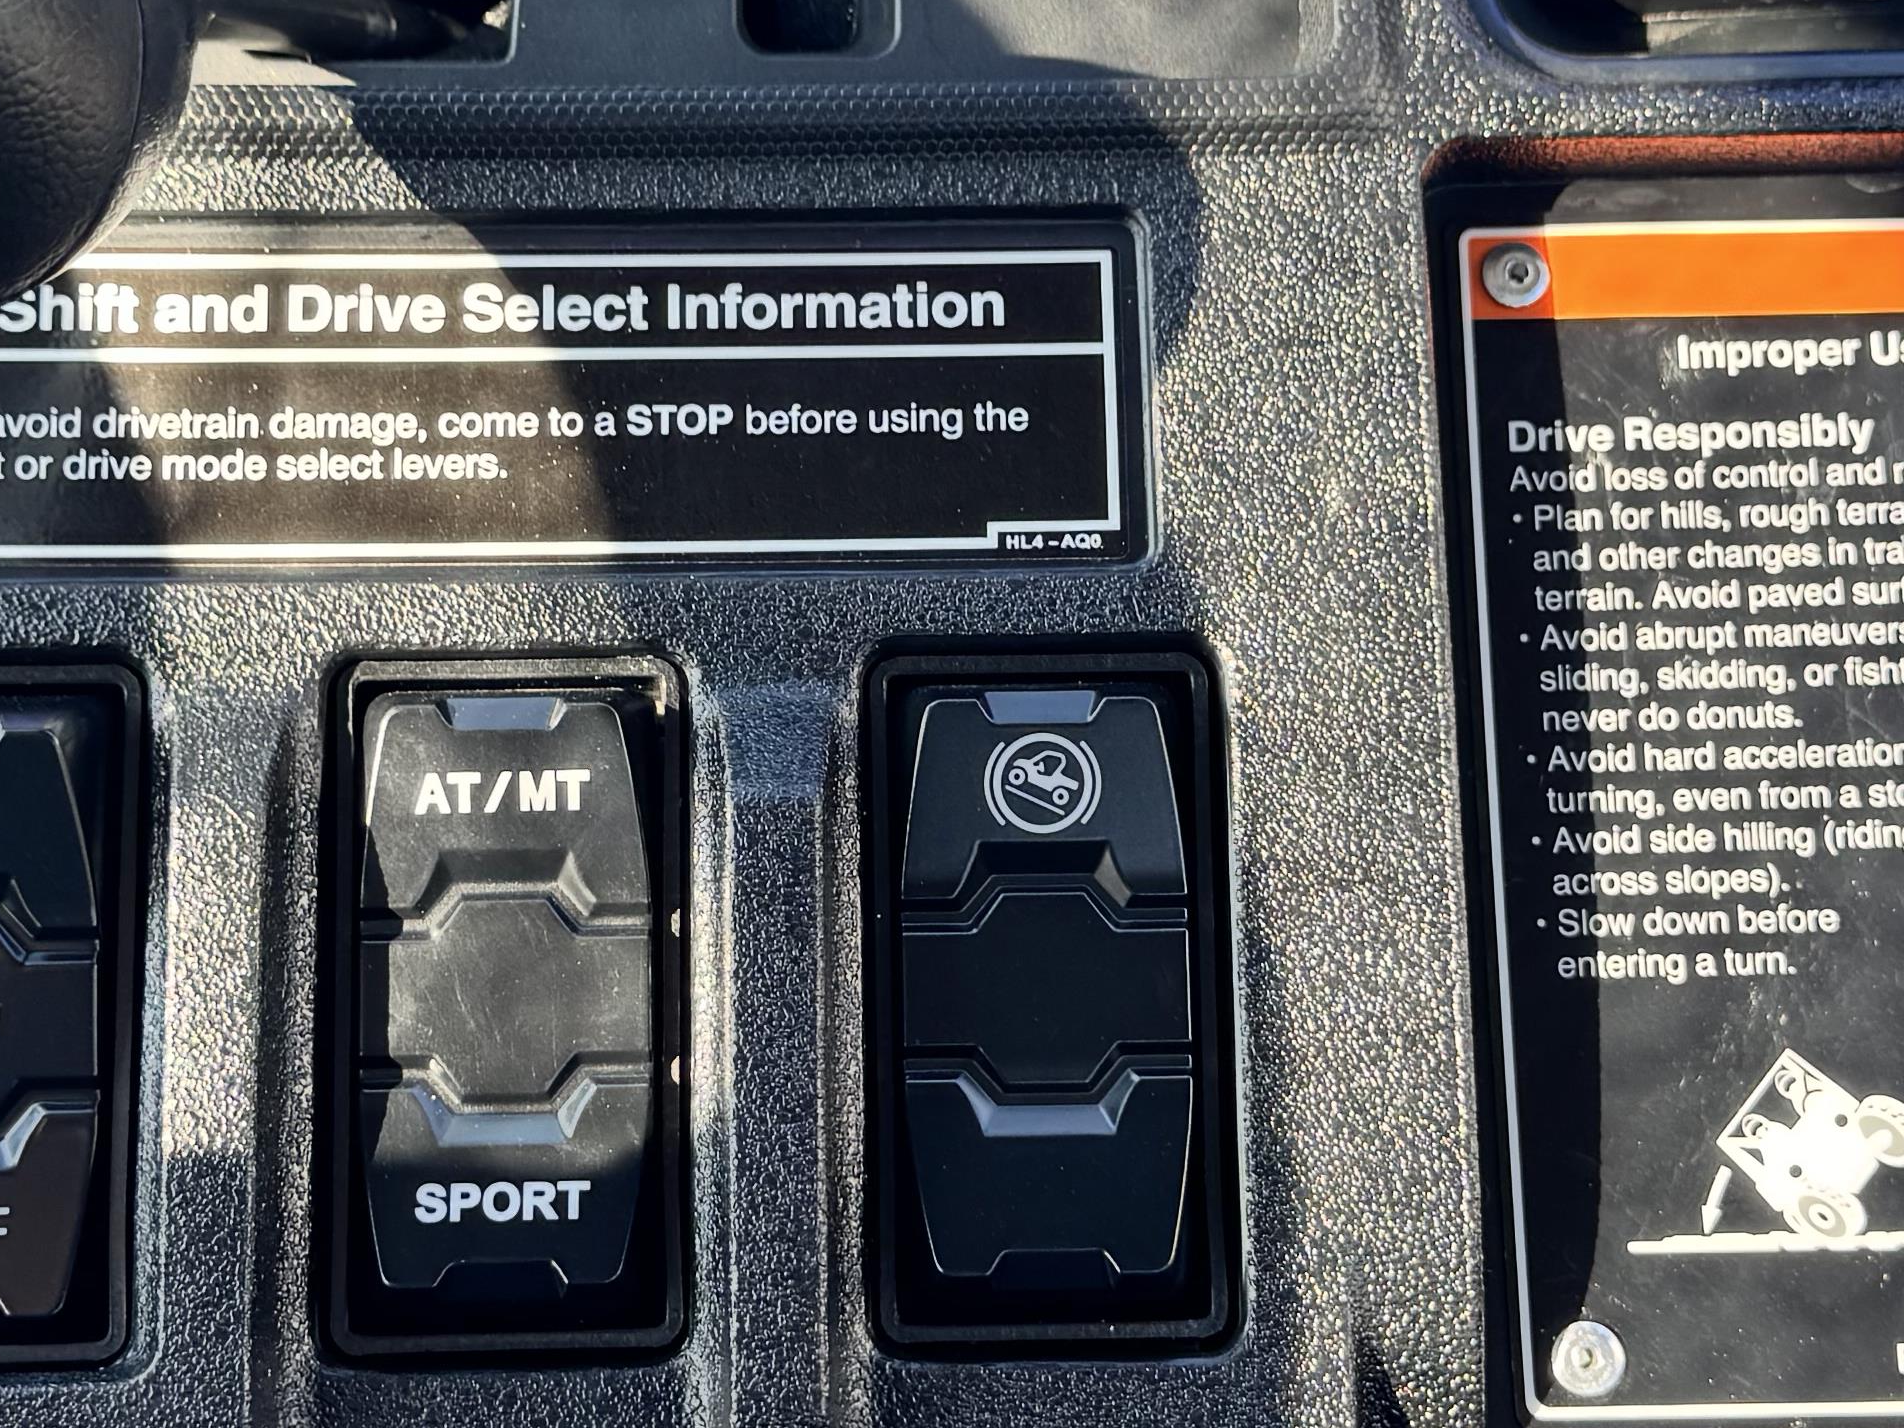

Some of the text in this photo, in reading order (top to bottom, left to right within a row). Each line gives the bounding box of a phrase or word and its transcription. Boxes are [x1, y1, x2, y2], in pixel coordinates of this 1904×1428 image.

[153, 283, 269, 334] and
[287, 282, 447, 334] Drive
[462, 281, 649, 333] Select
[667, 280, 1005, 330] Information
[1676, 334, 1863, 376] Improper
[92, 405, 265, 440] drivetrain
[268, 404, 428, 445] damage,
[437, 410, 540, 438] come
[547, 406, 584, 437] to
[593, 400, 617, 437] a
[626, 402, 734, 437] STOP
[745, 402, 858, 435] before
[868, 400, 964, 440] using
[973, 400, 1029, 432] the
[1507, 410, 1876, 462] Drive Responsibly
[14, 454, 54, 481] or
[62, 447, 153, 481] drive
[161, 447, 268, 482] mode
[275, 446, 385, 486] select
[390, 446, 509, 481] levers.
[1509, 458, 1597, 493] Avoid
[1603, 458, 1669, 492] loss
[1673, 459, 1707, 490] of
[1712, 456, 1820, 494] control
[1825, 455, 1888, 488] and
[1534, 503, 1604, 532] Plan
[1609, 500, 1655, 531] for
[1660, 498, 1732, 532] hills,
[1739, 496, 1831, 535] rough
[1534, 580, 1643, 612] terrain.
[1651, 577, 1741, 610] Avoid
[1747, 576, 1845, 614] paved
[1540, 620, 1629, 652] Avoid
[1635, 619, 1738, 656] abrupt
[1542, 699, 1803, 732] never do donuts.
[1548, 741, 1636, 773] Avoid
[1643, 740, 1716, 771] hard
[414, 768, 590, 815] AT/MT
[1552, 823, 1642, 854] Avoid
[1649, 822, 1716, 853] side
[1723, 820, 1816, 857] hilling
[1558, 901, 1841, 940] Slow down before
[1557, 946, 1798, 985] entering a turn.
[414, 1180, 590, 1224] SPORT
